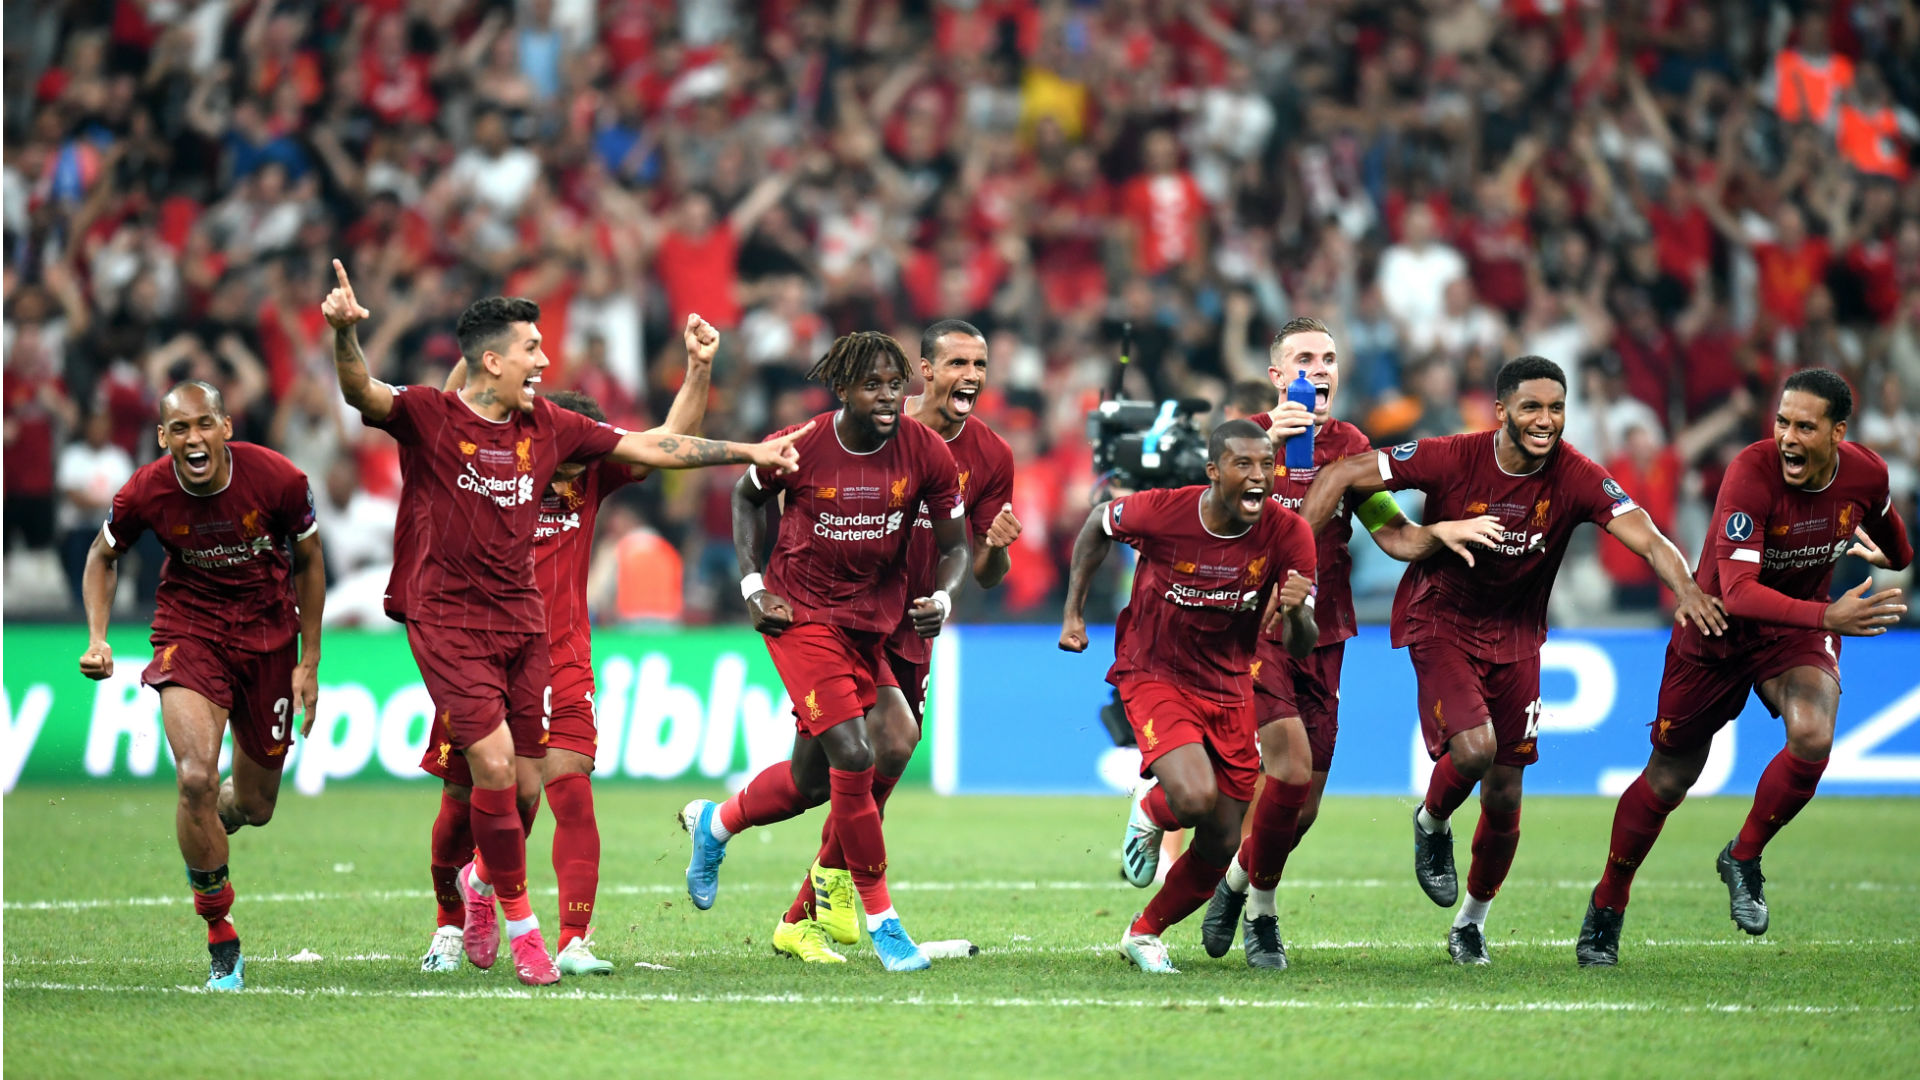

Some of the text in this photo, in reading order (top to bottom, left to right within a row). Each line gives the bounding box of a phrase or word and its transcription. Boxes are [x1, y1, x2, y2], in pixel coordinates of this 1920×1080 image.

[819, 511, 886, 526] Standard
[813, 522, 885, 541] Chartered
[181, 551, 252, 569] Chartered
[182, 543, 248, 559] Standard
[1765, 542, 1830, 560] Standard
[1761, 555, 1828, 570] Chartered
[1172, 583, 1241, 601] Standard
[271, 697, 289, 741] 3
[568, 901, 591, 912] LFC
